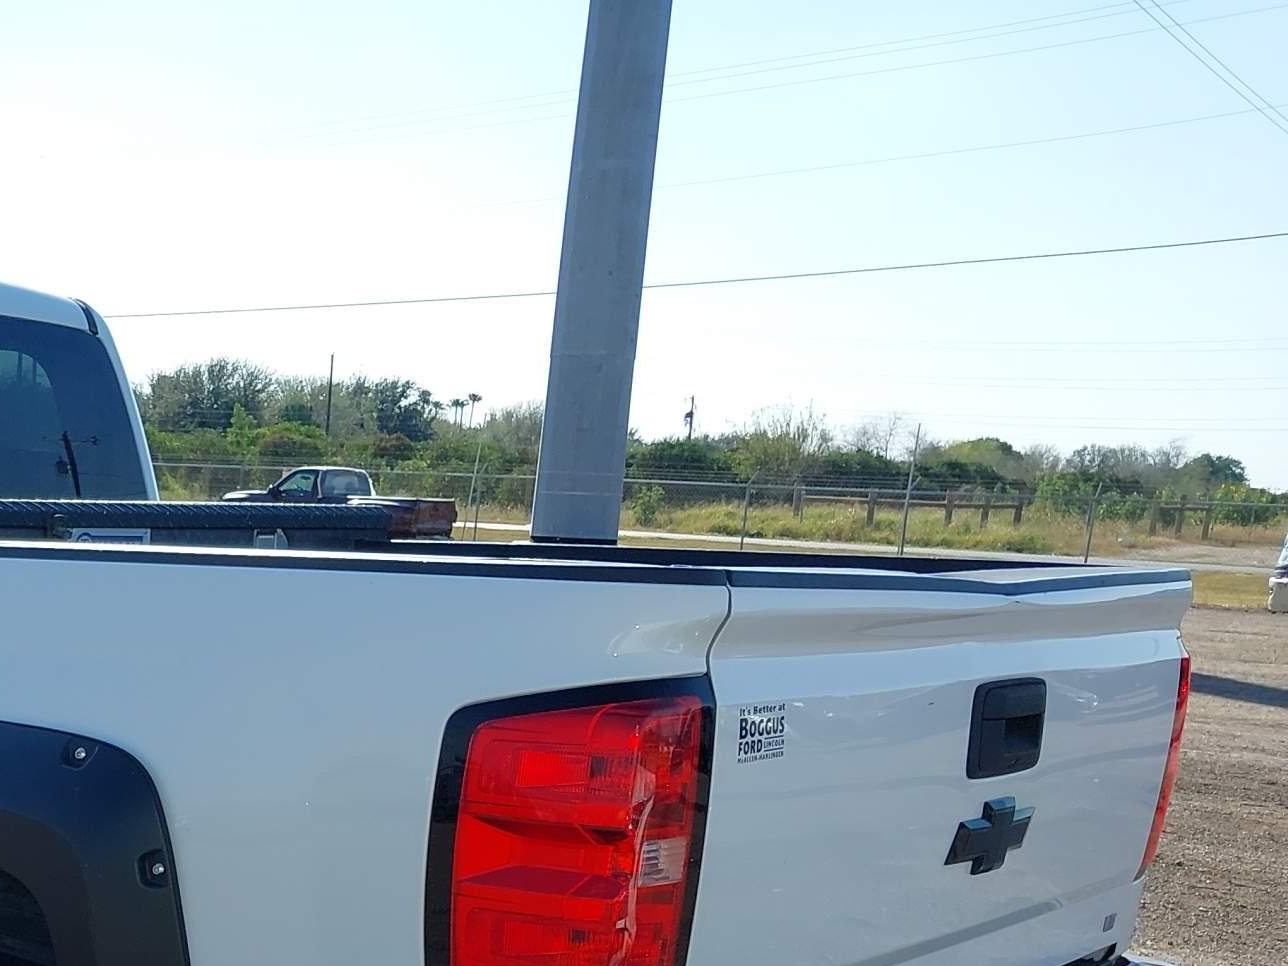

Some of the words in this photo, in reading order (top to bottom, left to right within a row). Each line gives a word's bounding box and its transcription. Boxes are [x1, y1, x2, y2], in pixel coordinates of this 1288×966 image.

[753, 704, 776, 715] Better
[778, 703, 785, 711] at
[739, 716, 785, 740] BOGGUS
[738, 739, 763, 757] FORD
[764, 739, 785, 749] LINCOLN
